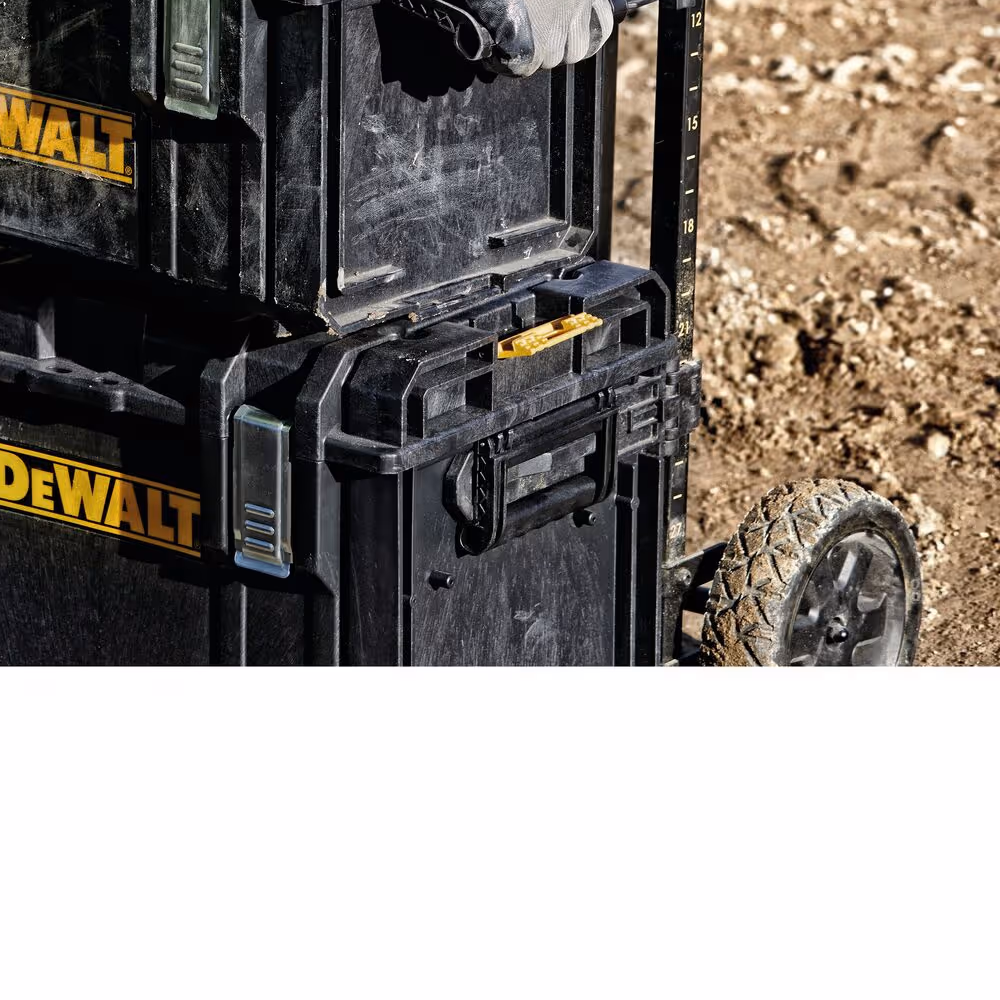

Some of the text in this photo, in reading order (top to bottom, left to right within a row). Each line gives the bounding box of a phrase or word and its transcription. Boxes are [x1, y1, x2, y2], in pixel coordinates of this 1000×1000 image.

[691, 11, 702, 28] 12
[687, 115, 699, 132] 15
[683, 218, 694, 235] 18
[678, 321, 690, 338] 21
[669, 522, 682, 539] 27
